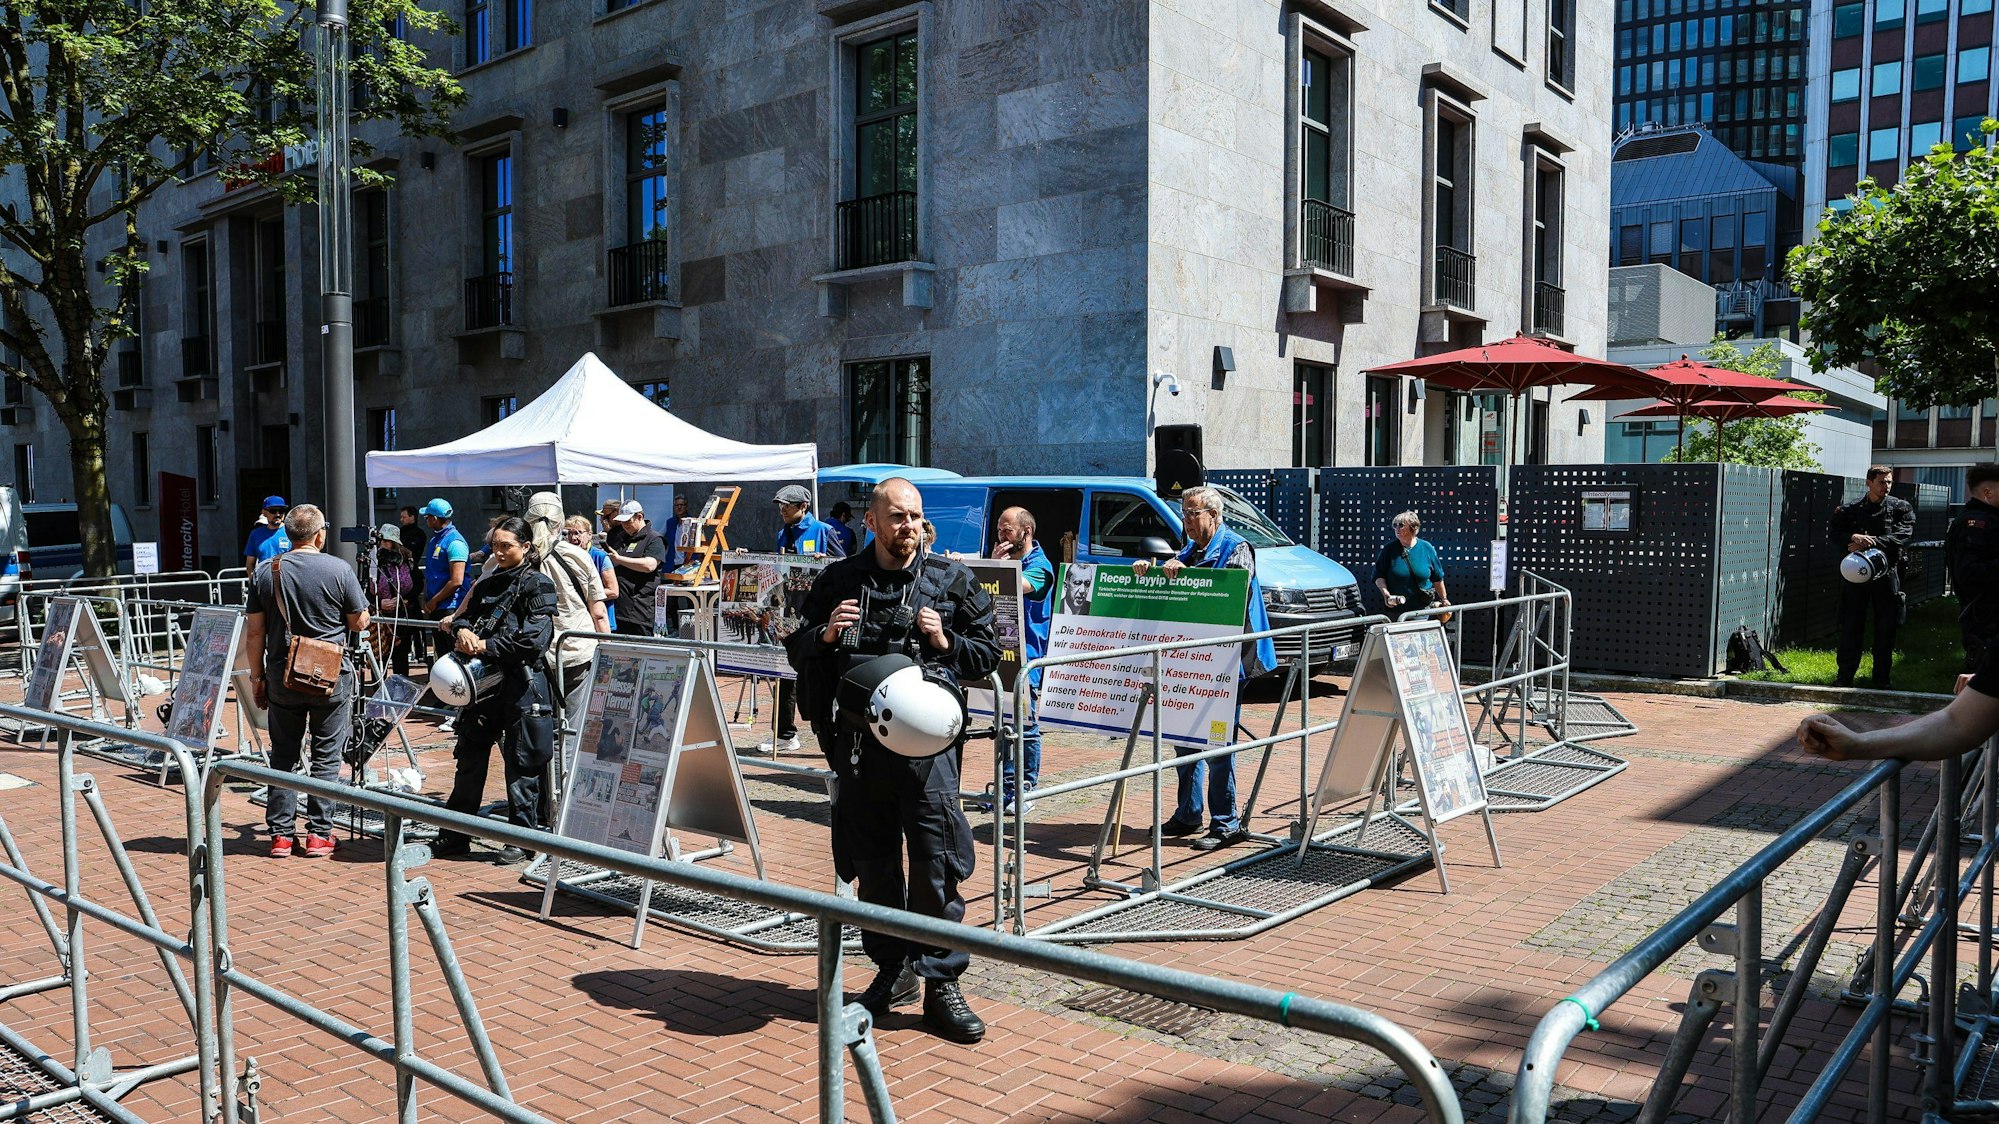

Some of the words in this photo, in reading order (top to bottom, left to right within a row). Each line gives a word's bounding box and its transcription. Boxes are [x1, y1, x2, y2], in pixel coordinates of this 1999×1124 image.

[1100, 572, 1131, 586] Recep
[1135, 574, 1166, 587] Tayyip
[1169, 576, 1213, 589] Erdogan
[1076, 627, 1126, 639] Demokratie
[1128, 631, 1140, 640] ist
[1141, 633, 1157, 641] nur
[1159, 634, 1175, 643] der
[1054, 640, 1068, 649] wir
[1170, 649, 1188, 659] Ziel
[1191, 651, 1213, 662] sind.
[1112, 663, 1132, 673] sind
[1165, 668, 1214, 682] Kasernen,
[1216, 673, 1231, 683] die
[1049, 670, 1091, 683] Minarette
[1092, 677, 1123, 686] unsere
[1173, 684, 1187, 694] die
[1189, 685, 1230, 699] Kuppeln
[606, 693, 633, 710] Terror!
[1047, 686, 1077, 696] unsere
[1079, 688, 1108, 700] Helme
[1110, 693, 1128, 702] und
[1130, 694, 1140, 704] di
[1045, 700, 1075, 710] unsere
